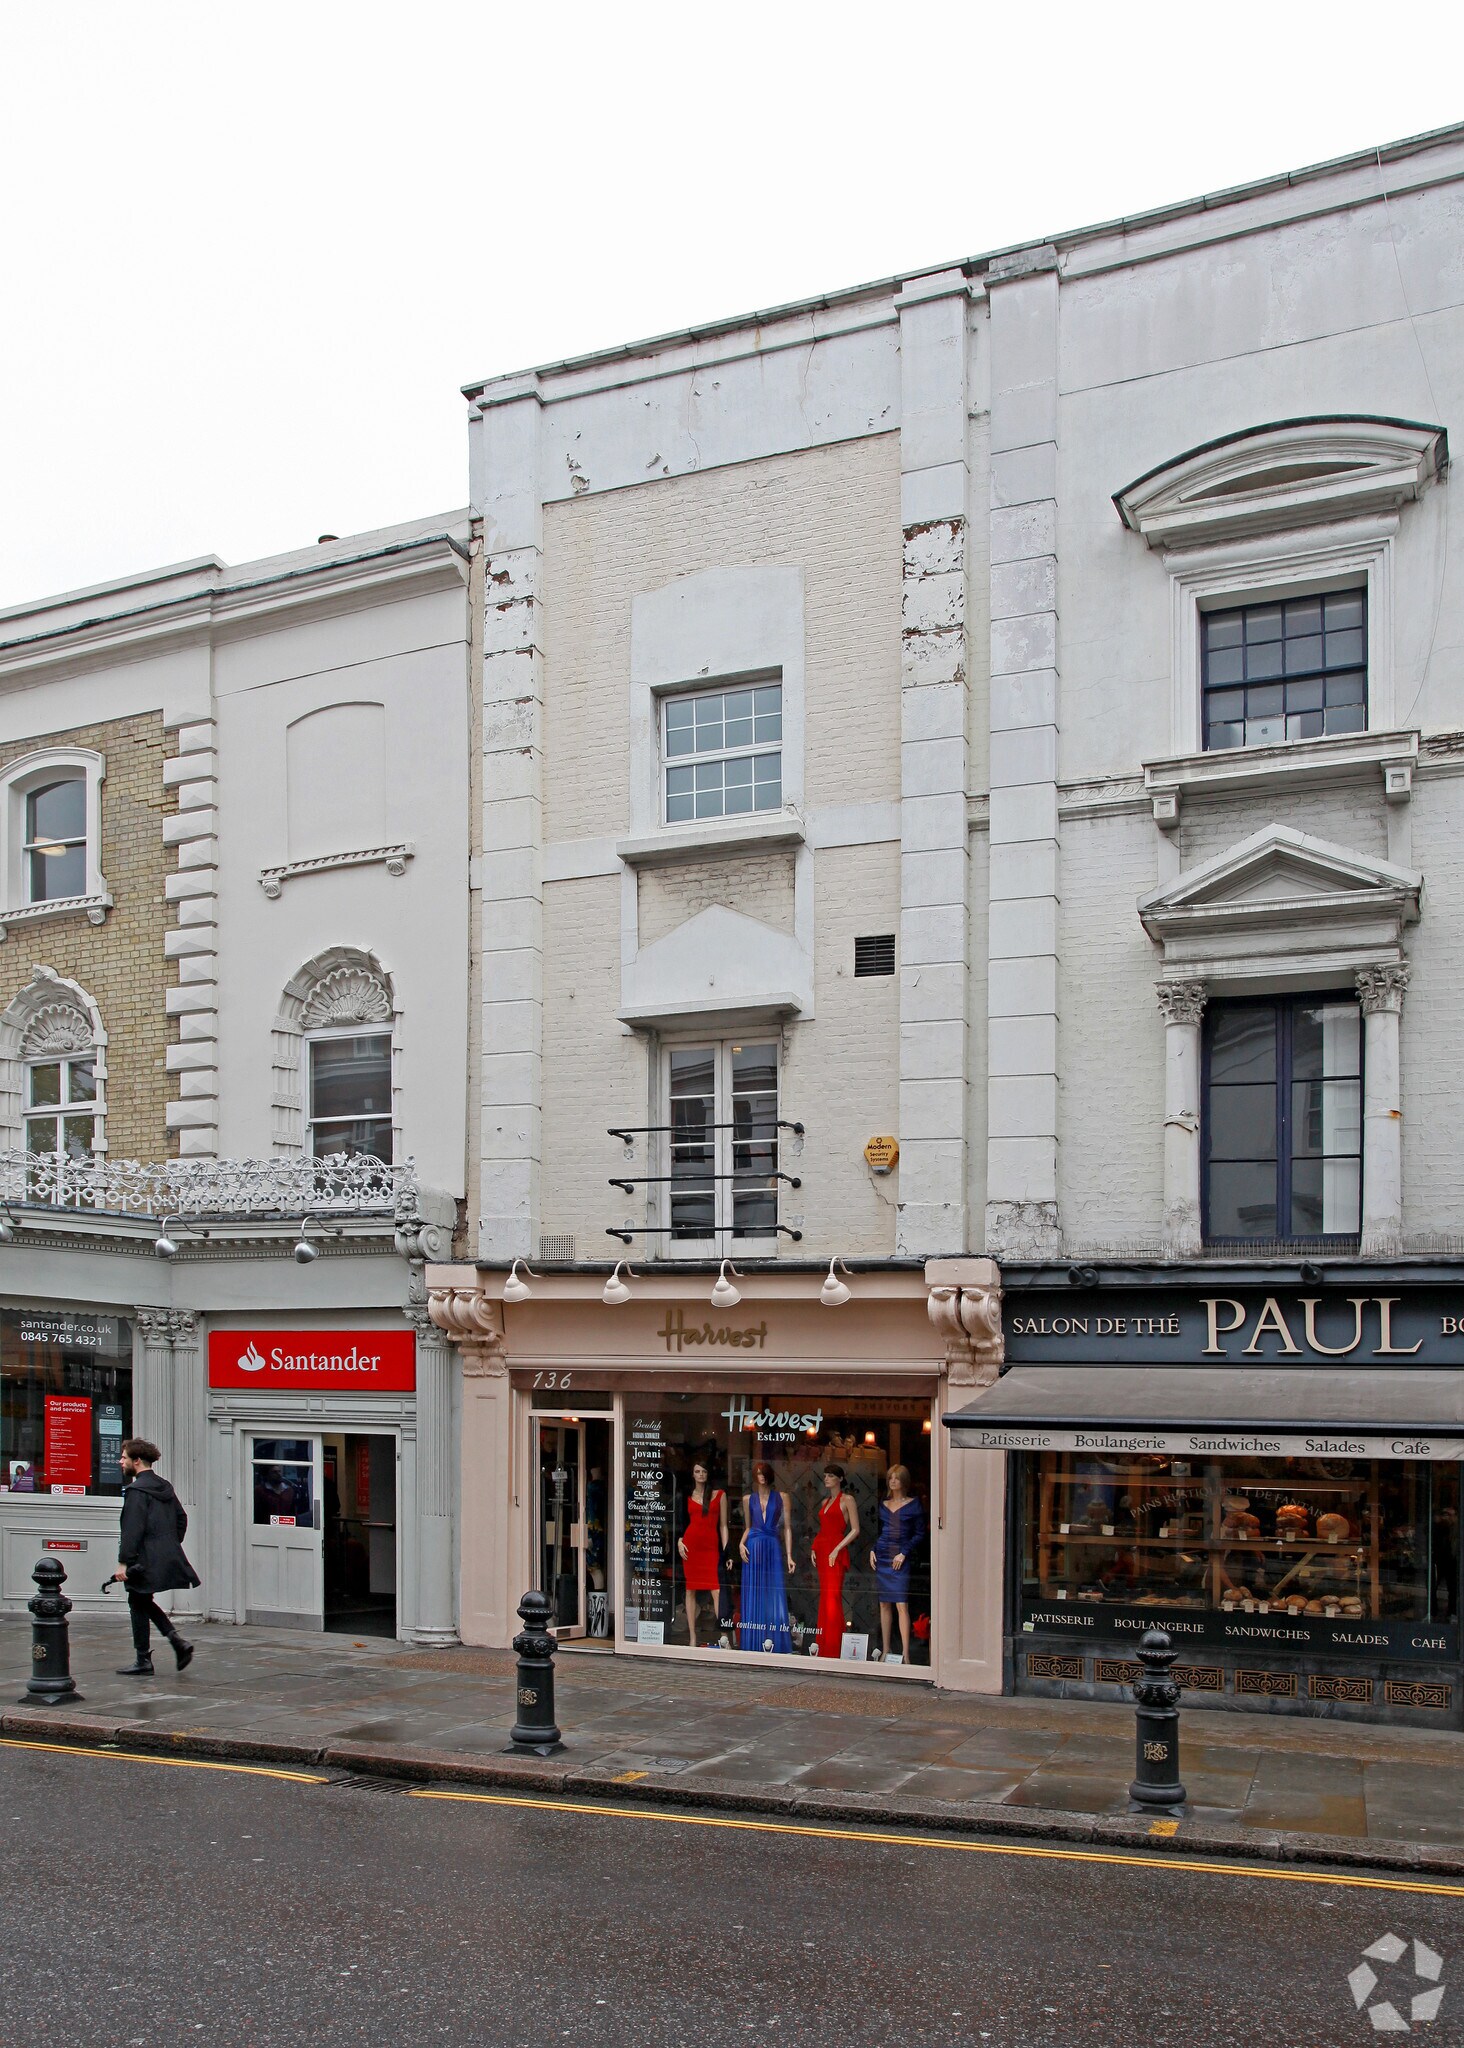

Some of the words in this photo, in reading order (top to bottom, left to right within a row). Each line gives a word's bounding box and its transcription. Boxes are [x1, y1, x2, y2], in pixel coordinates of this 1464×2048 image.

[20, 1320, 112, 1334] santander.co.uk
[657, 1309, 768, 1353] Harvest
[1012, 1317, 1089, 1336] SALON
[1095, 1318, 1127, 1335] DE
[1130, 1313, 1181, 1335] THÉ
[1199, 1297, 1425, 1355] PAUL
[20, 1331, 49, 1343] 0845
[51, 1333, 73, 1344] 765
[75, 1336, 102, 1346] 4321
[270, 1346, 381, 1372] Santander
[532, 1371, 573, 1389] 136
[720, 1395, 824, 1433] Harvest
[756, 1431, 796, 1442] Est.1970
[981, 1432, 1051, 1447] Patisserie
[1074, 1434, 1166, 1451] Boulangerie
[1189, 1437, 1281, 1452] Sandwiches
[1305, 1439, 1366, 1454] Salades
[1391, 1441, 1431, 1455] Café
[632, 1447, 661, 1460] Jovani
[630, 1470, 664, 1480] PINKO
[633, 1490, 660, 1498] CLASS
[1129, 1496, 1161, 1519] PAINS
[1255, 1489, 1274, 1501] DE
[633, 1528, 660, 1537] SCALA
[720, 1617, 734, 1628] Sale
[736, 1620, 767, 1631] continues
[769, 1622, 777, 1631] in
[779, 1623, 790, 1633] the
[792, 1624, 823, 1635] basement
[1031, 1613, 1095, 1626] PATISSERIE
[1114, 1618, 1205, 1633] BOULANGERIE
[1225, 1625, 1311, 1640] SANDWICHES
[1331, 1632, 1389, 1645] SALADES
[1411, 1636, 1447, 1649] CAFÉ
